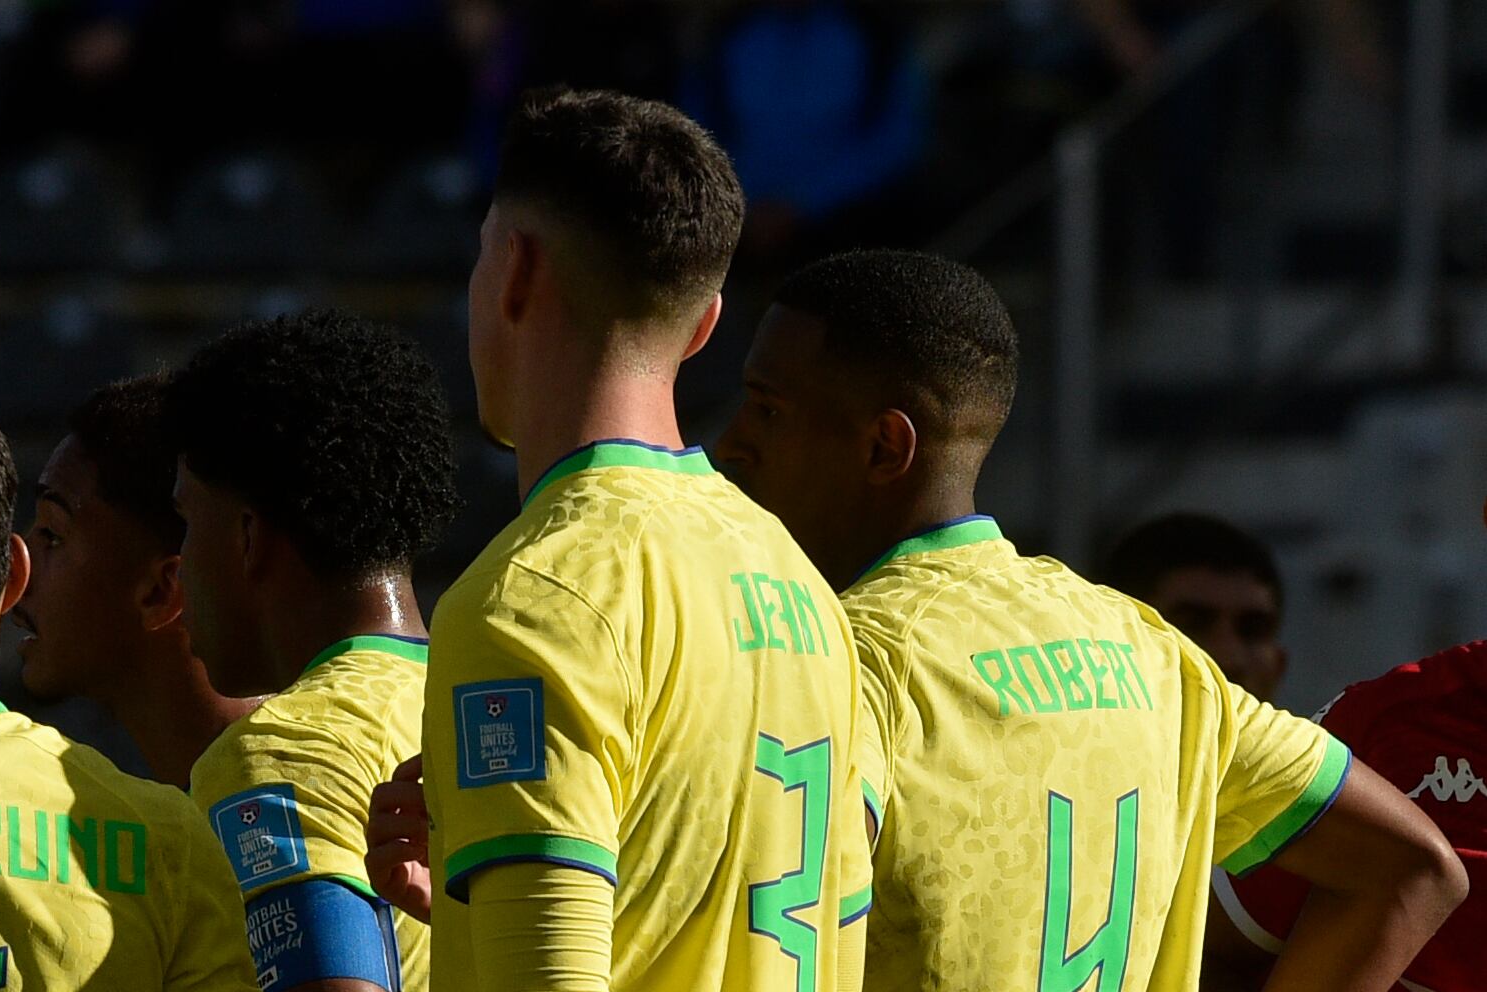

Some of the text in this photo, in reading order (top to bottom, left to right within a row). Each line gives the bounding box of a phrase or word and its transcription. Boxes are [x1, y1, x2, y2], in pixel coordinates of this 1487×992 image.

[971, 638, 1153, 717] ROBERT
[480, 732, 515, 747] UNITES
[240, 834, 275, 856] UNITES
[247, 898, 295, 929] OTBALL
[249, 911, 298, 953] NITES
